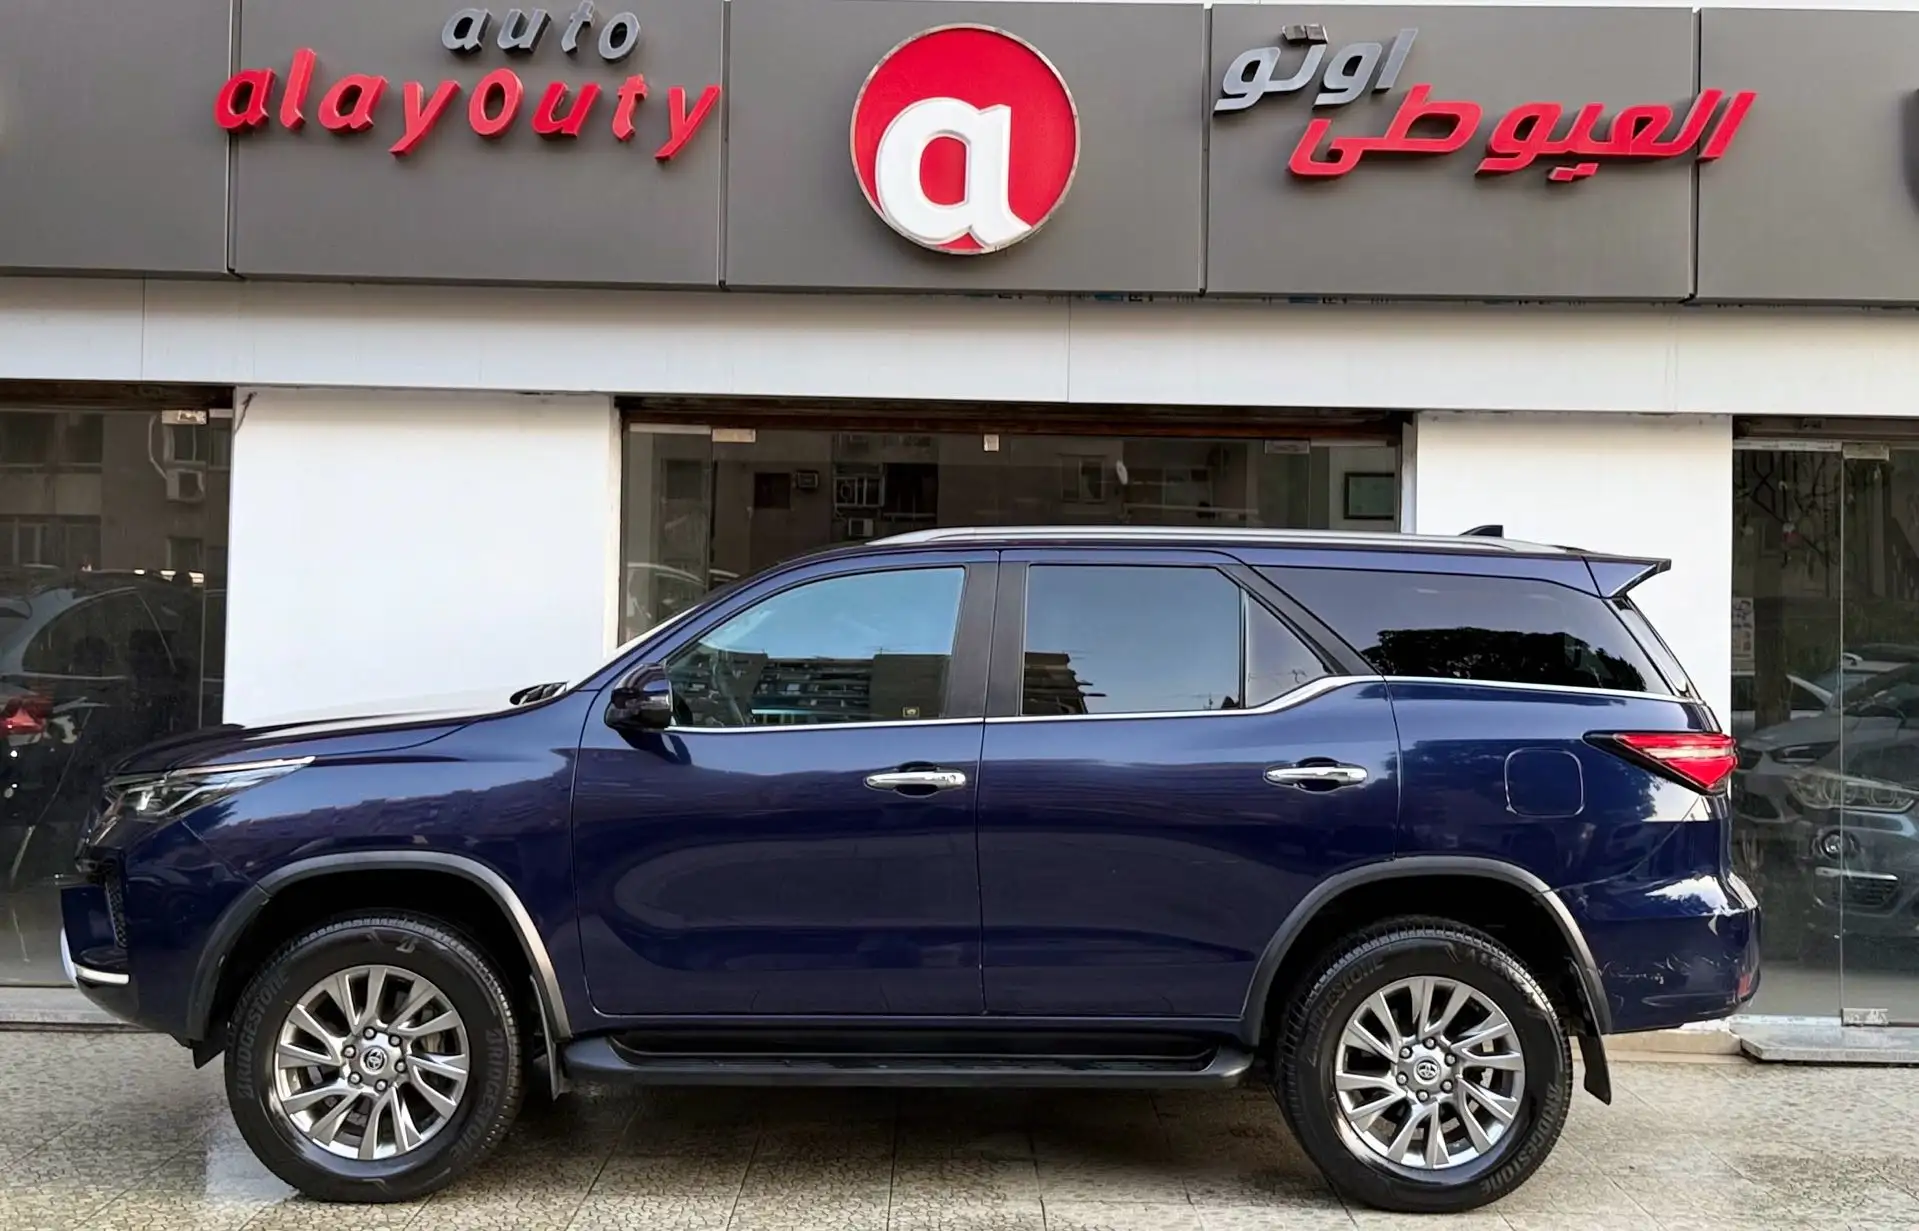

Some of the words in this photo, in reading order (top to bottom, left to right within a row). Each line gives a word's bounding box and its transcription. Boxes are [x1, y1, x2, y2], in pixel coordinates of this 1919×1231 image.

[441, 0, 642, 62] auto
[1213, 24, 1419, 113] اوتو
[214, 49, 721, 161] alayouty
[875, 97, 1032, 245] a
[237, 973, 290, 1099] BRIDGESTONE
[449, 1028, 506, 1161] BRIDGESTONE
[1480, 1082, 1563, 1194] BRIDGESTONE
